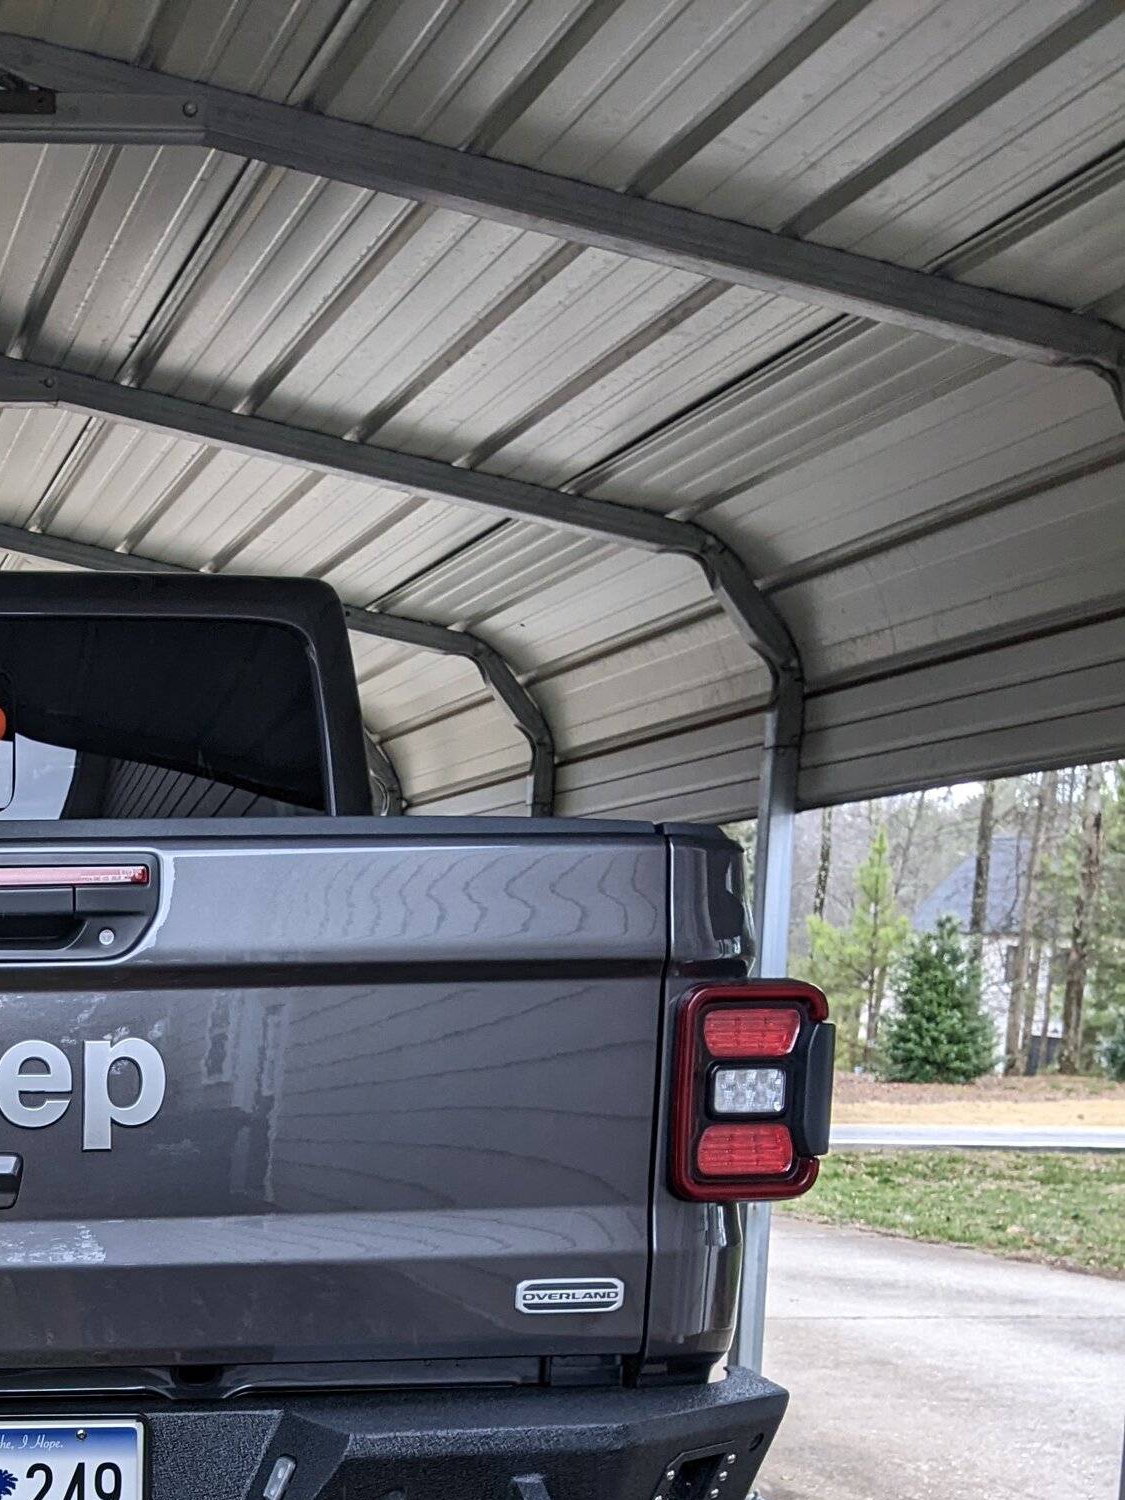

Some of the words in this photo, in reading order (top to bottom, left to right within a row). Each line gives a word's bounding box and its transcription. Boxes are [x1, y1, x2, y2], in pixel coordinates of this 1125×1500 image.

[522, 1290, 619, 1301] OVERLAND
[17, 1434, 29, 1450] I
[30, 1434, 64, 1451] Hope.
